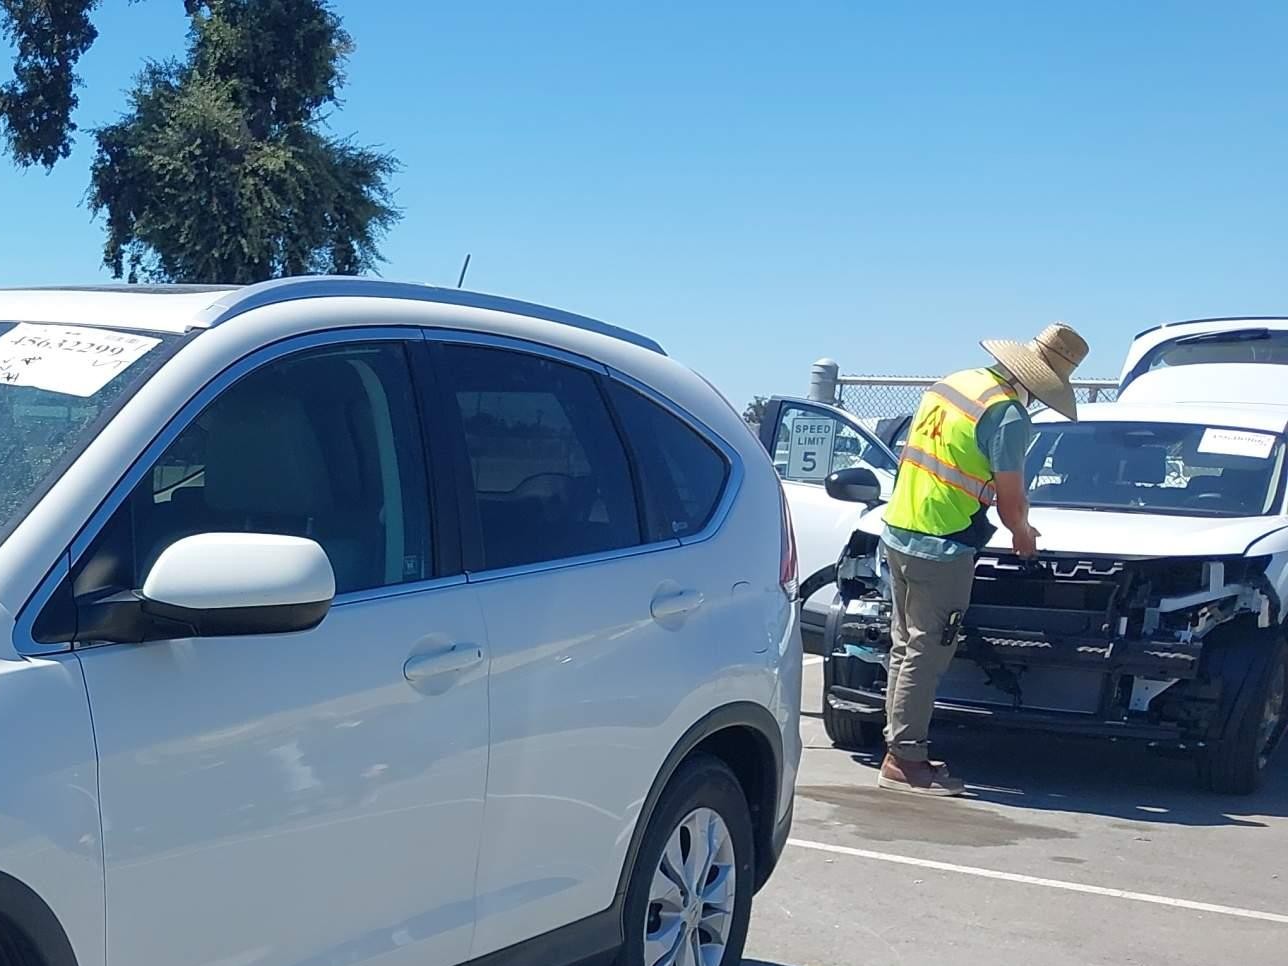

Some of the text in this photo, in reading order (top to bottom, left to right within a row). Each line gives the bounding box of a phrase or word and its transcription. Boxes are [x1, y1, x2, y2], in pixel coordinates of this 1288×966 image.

[795, 424, 831, 434] SPEED
[797, 436, 827, 446] LIMIT
[801, 451, 817, 472] 5
